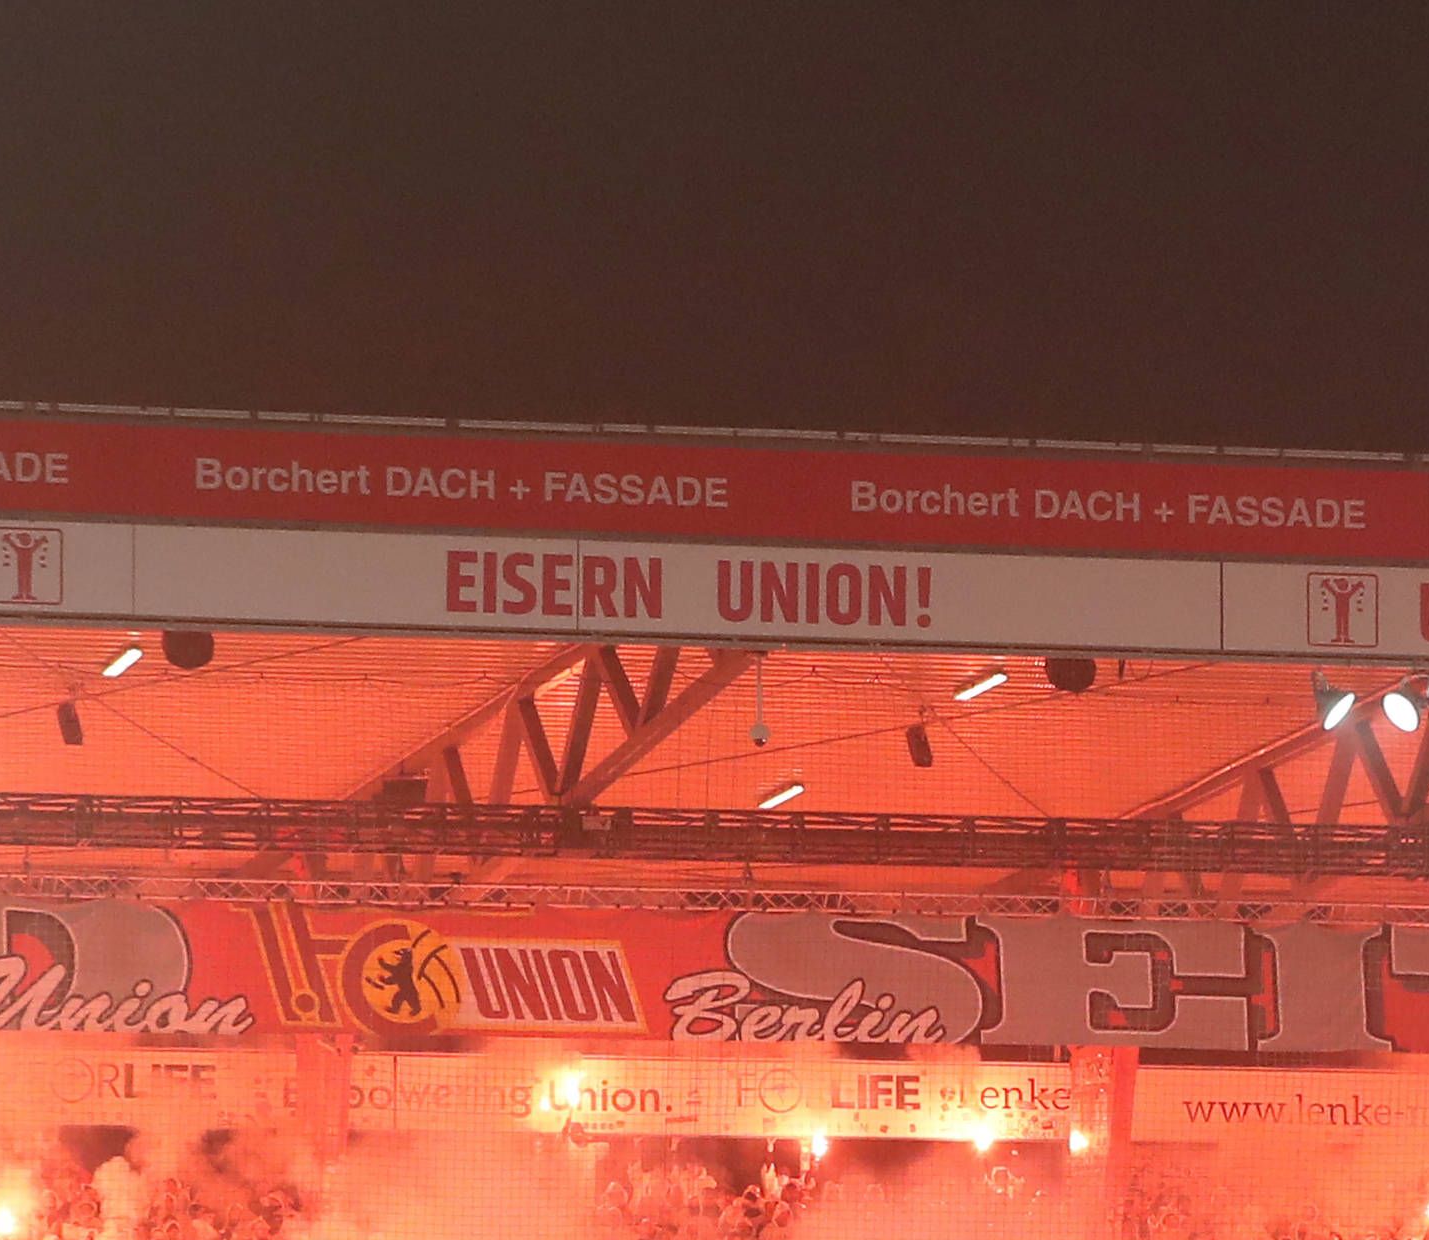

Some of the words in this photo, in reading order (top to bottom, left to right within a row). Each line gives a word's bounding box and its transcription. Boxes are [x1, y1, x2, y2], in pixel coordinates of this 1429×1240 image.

[195, 458, 372, 496] Borchert
[386, 466, 496, 500] DACH
[510, 479, 531, 501] +
[543, 472, 729, 509] FASSADE
[850, 481, 1019, 517] Borchert
[1034, 489, 1141, 523] DACH
[1154, 501, 1175, 522] +
[1187, 493, 1368, 530] FASSADE
[445, 549, 663, 620] EISERN
[717, 560, 934, 628] UNION!
[461, 946, 637, 1024] UNION
[663, 968, 945, 1042] Berlin
